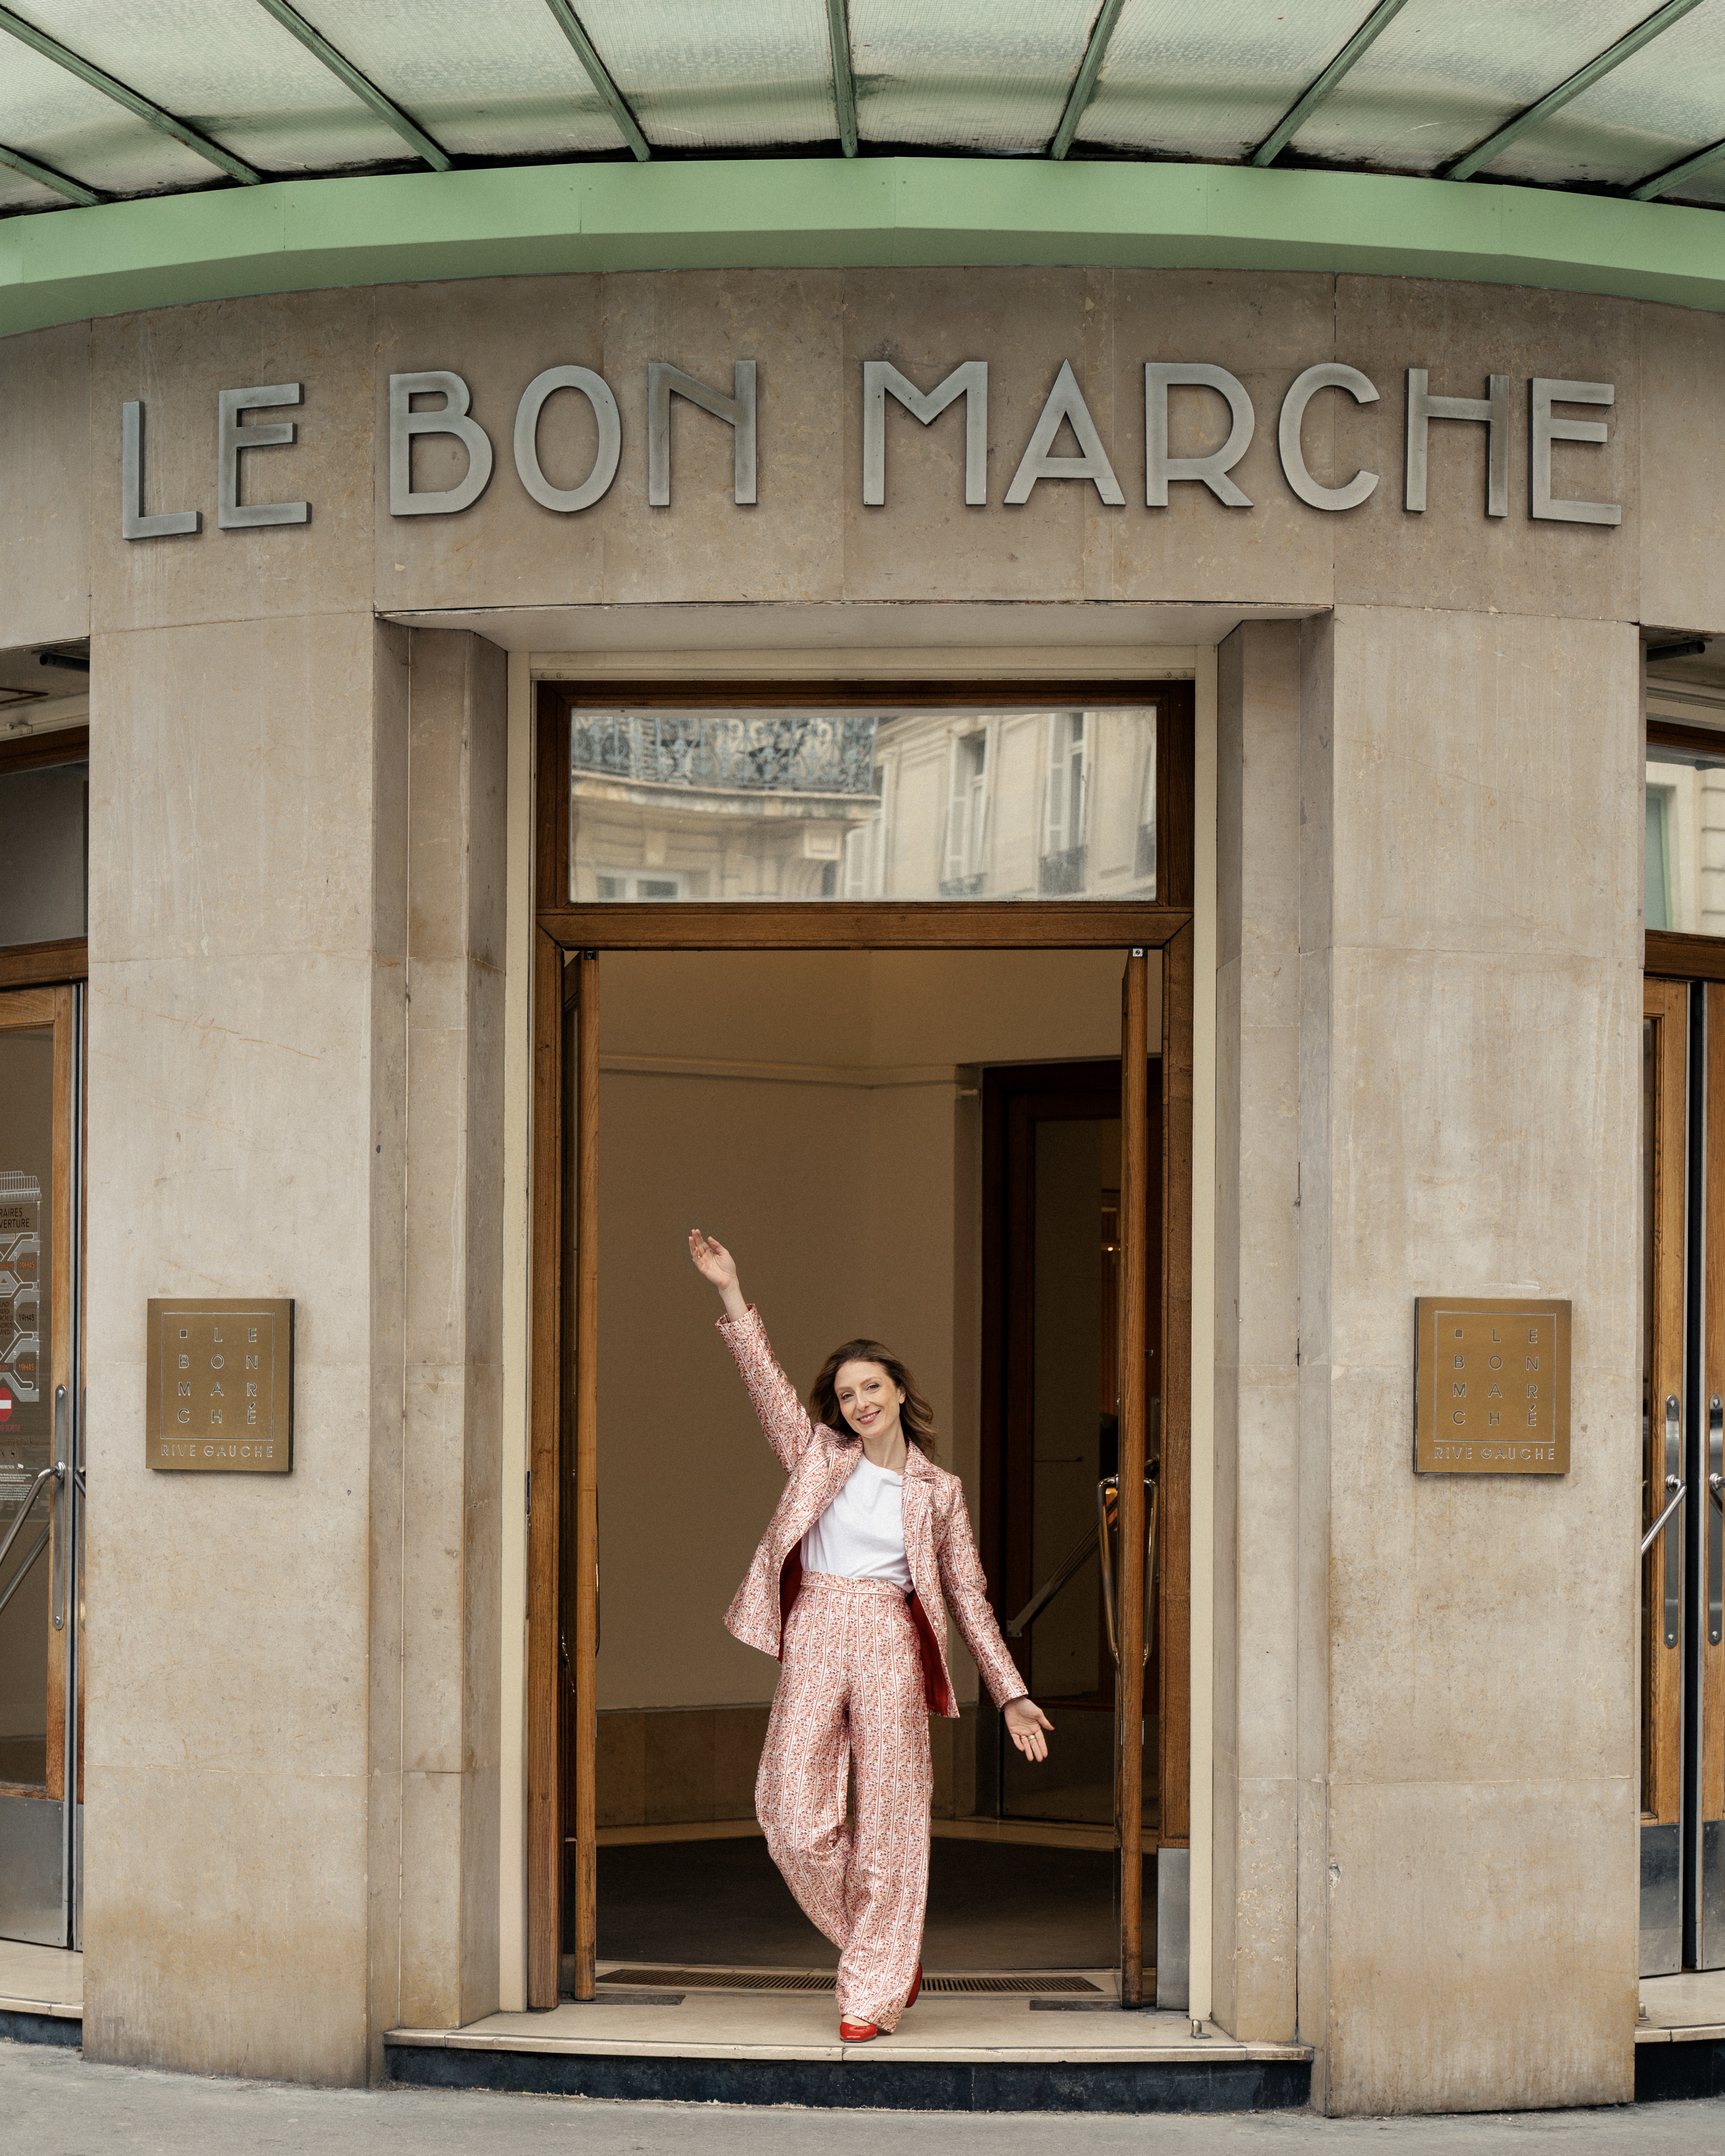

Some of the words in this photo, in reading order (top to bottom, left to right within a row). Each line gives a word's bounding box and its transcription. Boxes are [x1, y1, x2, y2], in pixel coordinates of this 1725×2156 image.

[122, 382, 313, 540] LE
[389, 360, 758, 518] BON
[863, 358, 1622, 528] MARCHE
[0, 1207, 22, 1218] RAIRES
[0, 1218, 29, 1228] VERTURE
[19, 1261, 35, 1269] 19H45
[214, 1328, 257, 1342] LE
[1492, 1328, 1537, 1343] LE
[179, 1354, 258, 1369] BON
[1454, 1355, 1538, 1371] BON
[162, 1445, 196, 1456] RIVE
[203, 1445, 273, 1457] GAUCHE
[1435, 1447, 1472, 1459] RIVE
[1481, 1447, 1554, 1460] GAUCHE
